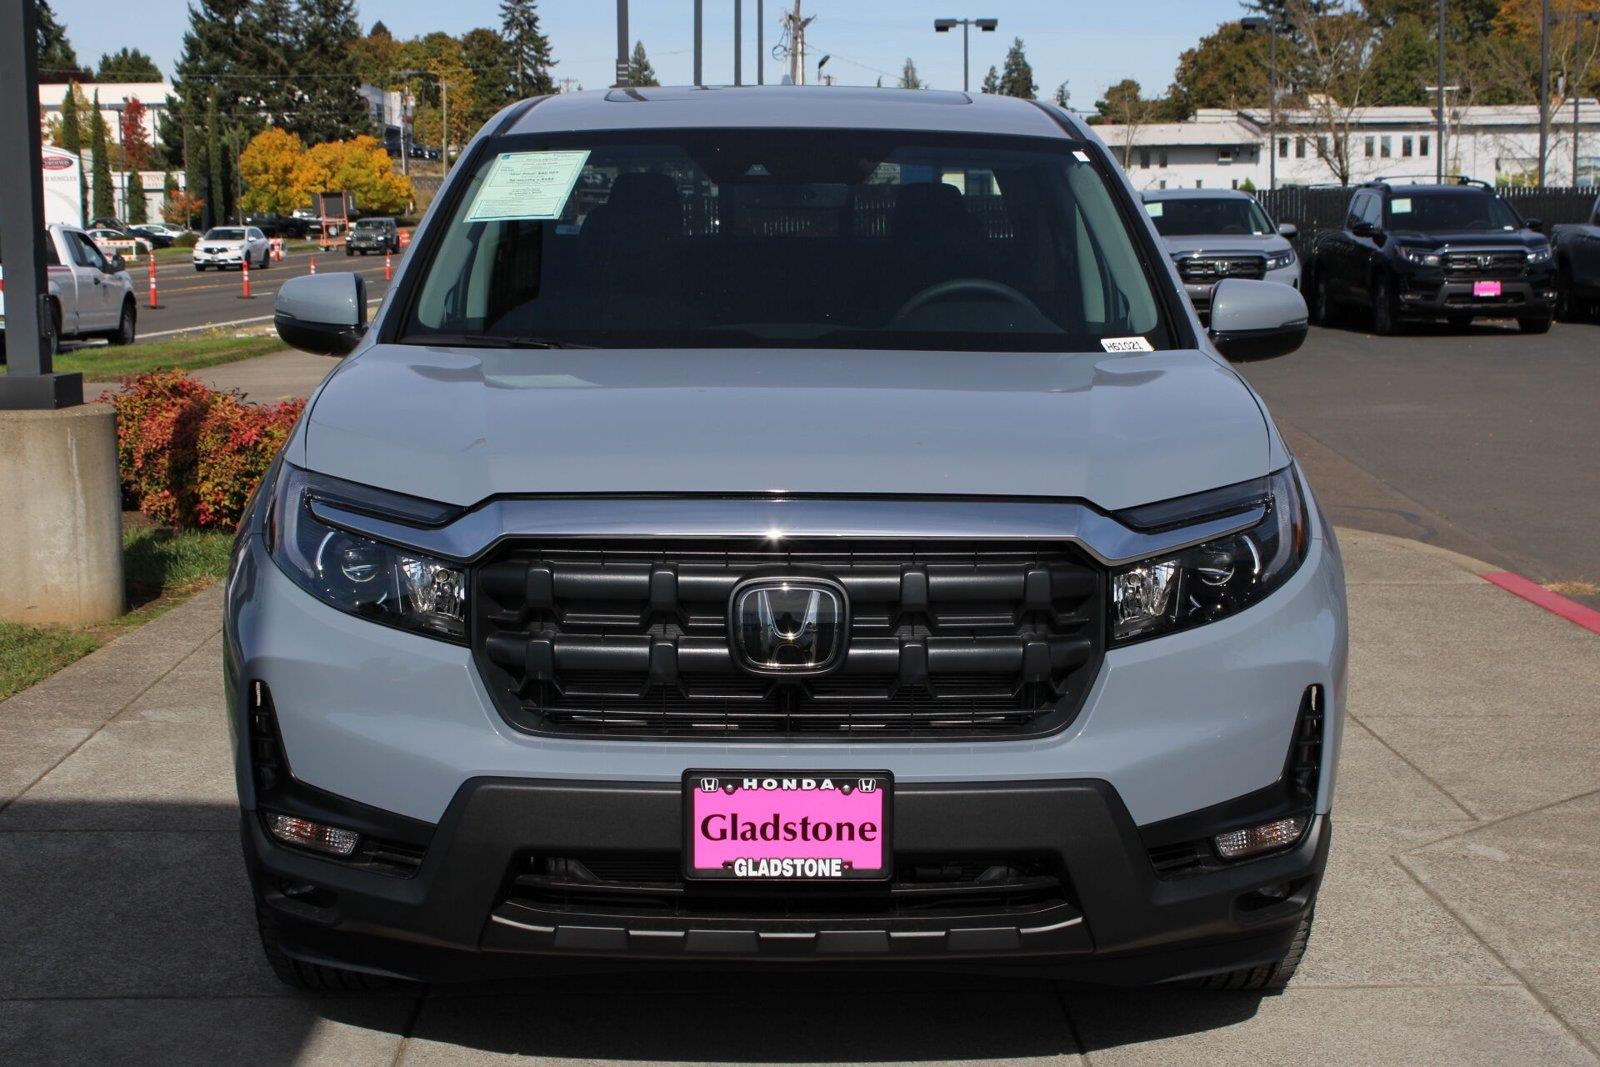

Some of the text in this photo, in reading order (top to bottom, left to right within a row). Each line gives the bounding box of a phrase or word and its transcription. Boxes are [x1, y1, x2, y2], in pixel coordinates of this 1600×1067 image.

[743, 778, 835, 790] HONDA
[700, 813, 878, 842] Gladstone
[734, 858, 842, 877] GLADSTONE
